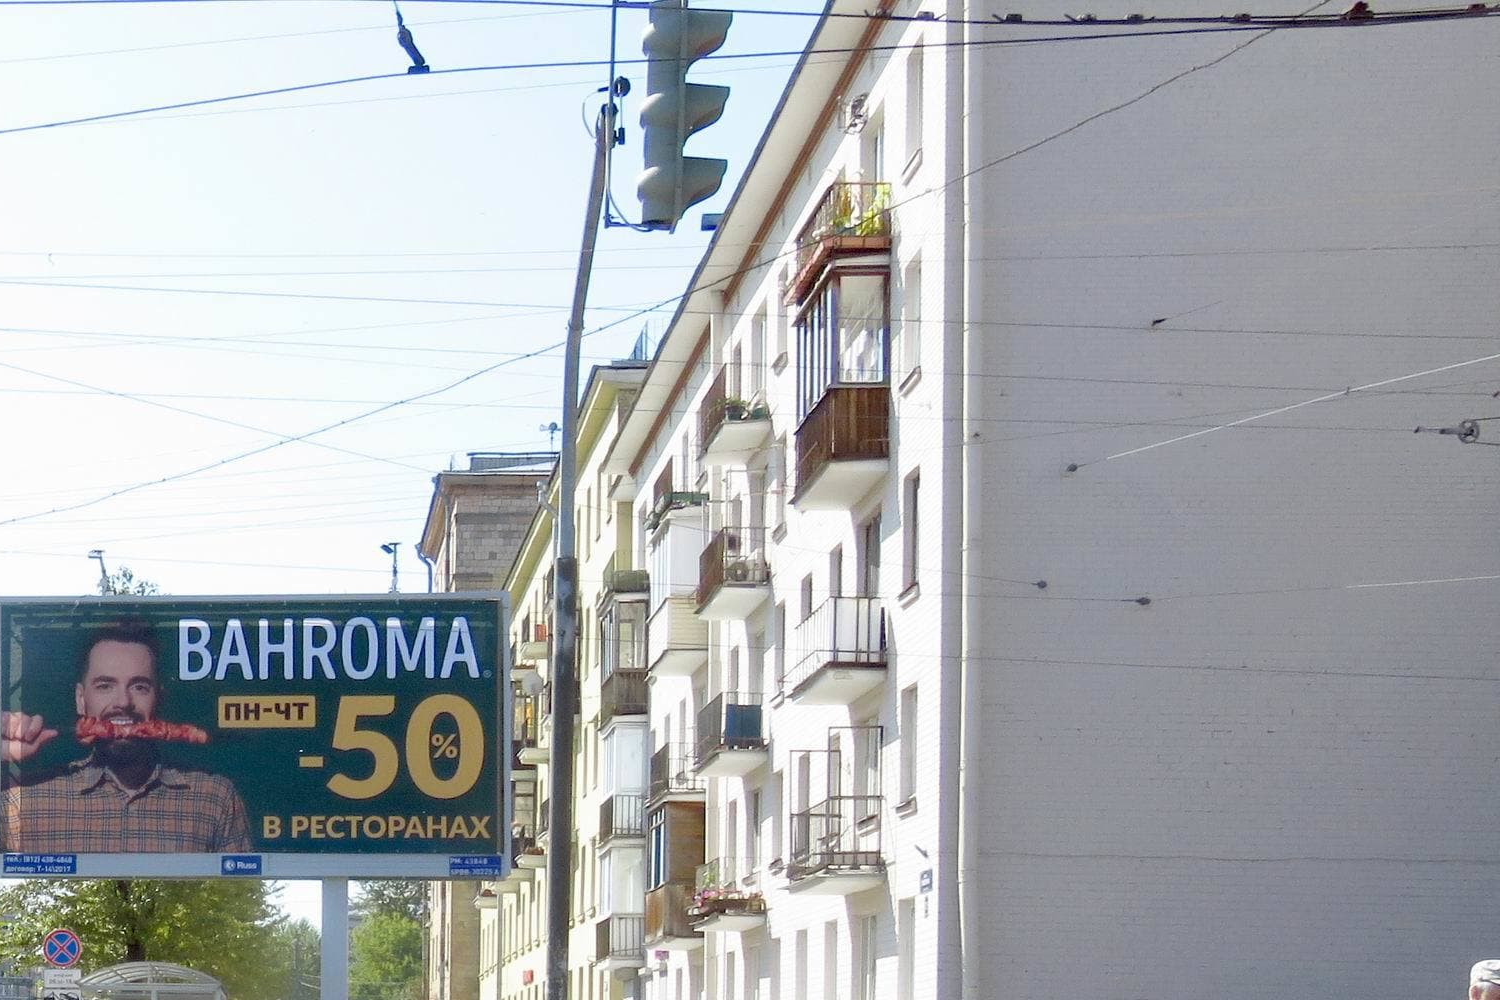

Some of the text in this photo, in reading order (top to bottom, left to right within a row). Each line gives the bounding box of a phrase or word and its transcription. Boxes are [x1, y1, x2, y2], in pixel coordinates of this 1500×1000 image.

[178, 616, 481, 681] BAHROMA
[224, 702, 310, 721] ПН-ЧТ
[262, 815, 491, 839] В РЕСТОРАНАХ
[236, 861, 258, 870] Russ
